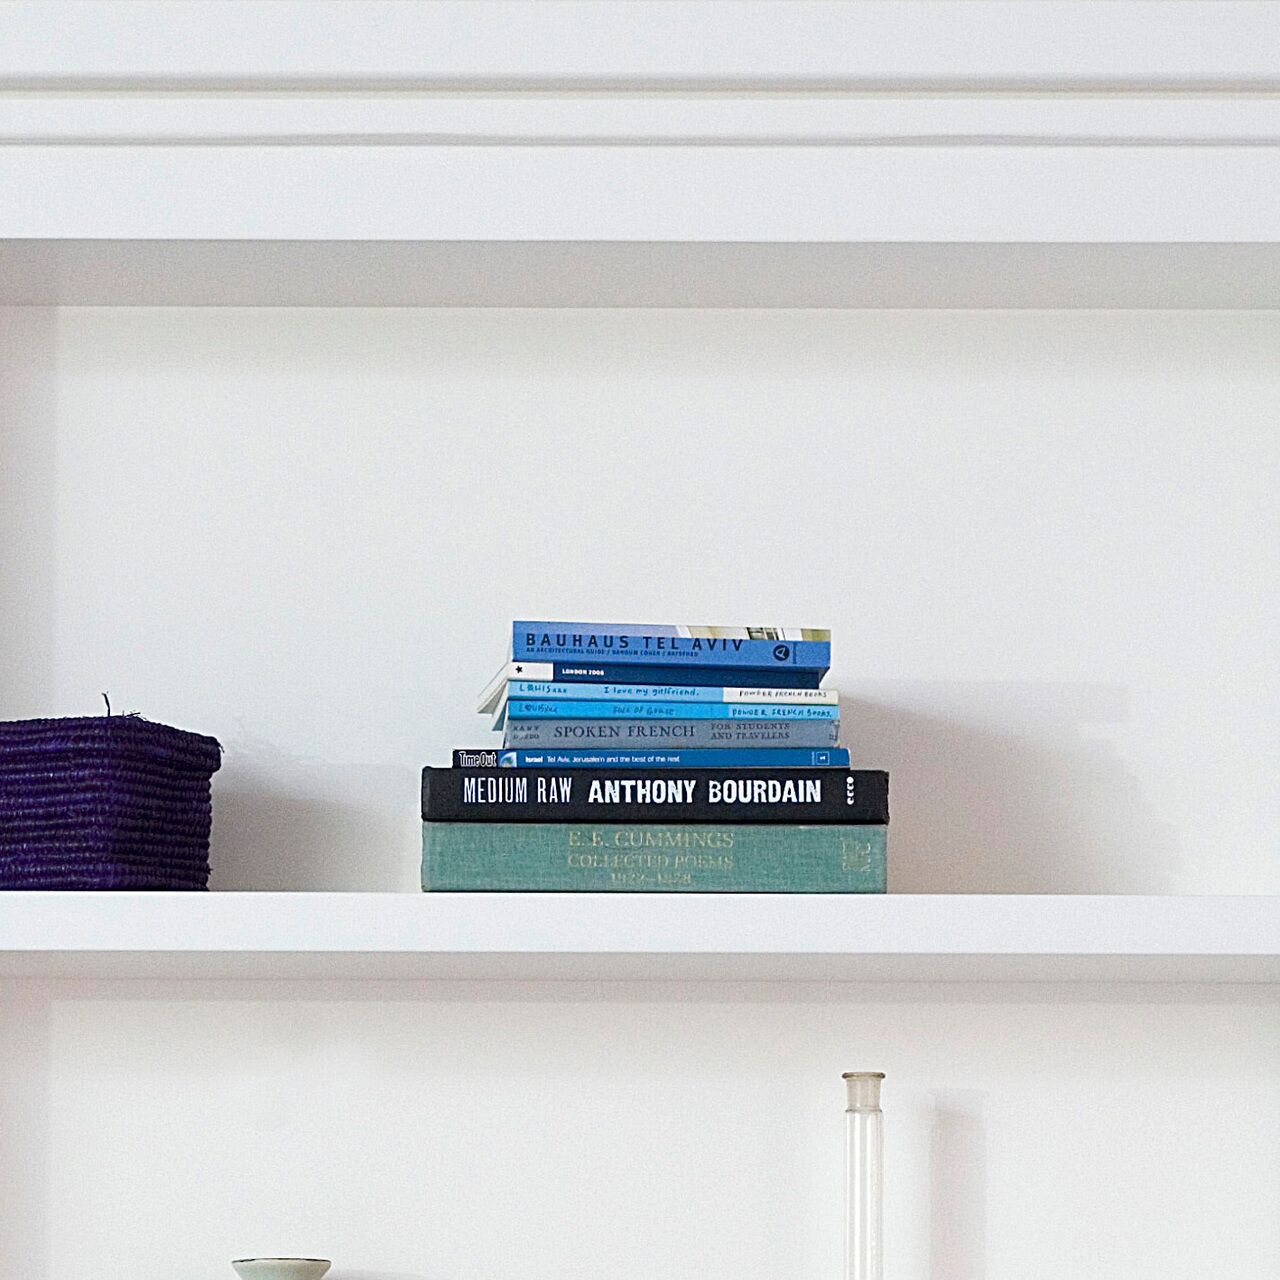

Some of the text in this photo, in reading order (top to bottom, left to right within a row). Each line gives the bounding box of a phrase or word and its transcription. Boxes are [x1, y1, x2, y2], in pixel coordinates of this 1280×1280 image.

[526, 633, 744, 651] BAUHAUS TEL AVIV
[562, 668, 587, 676] LONDON
[613, 686, 632, 694] love
[636, 687, 648, 697] my
[554, 725, 695, 738] SPOKEN FRENCH
[736, 722, 790, 730] STUDENTS
[710, 732, 790, 740] AND TRAVELERS
[463, 777, 822, 804] MEDIUM RAW ANTHONY BOURDAIN
[568, 831, 735, 848] E. E. CUMMINGS
[568, 853, 734, 869] COLLECTED POEMS
